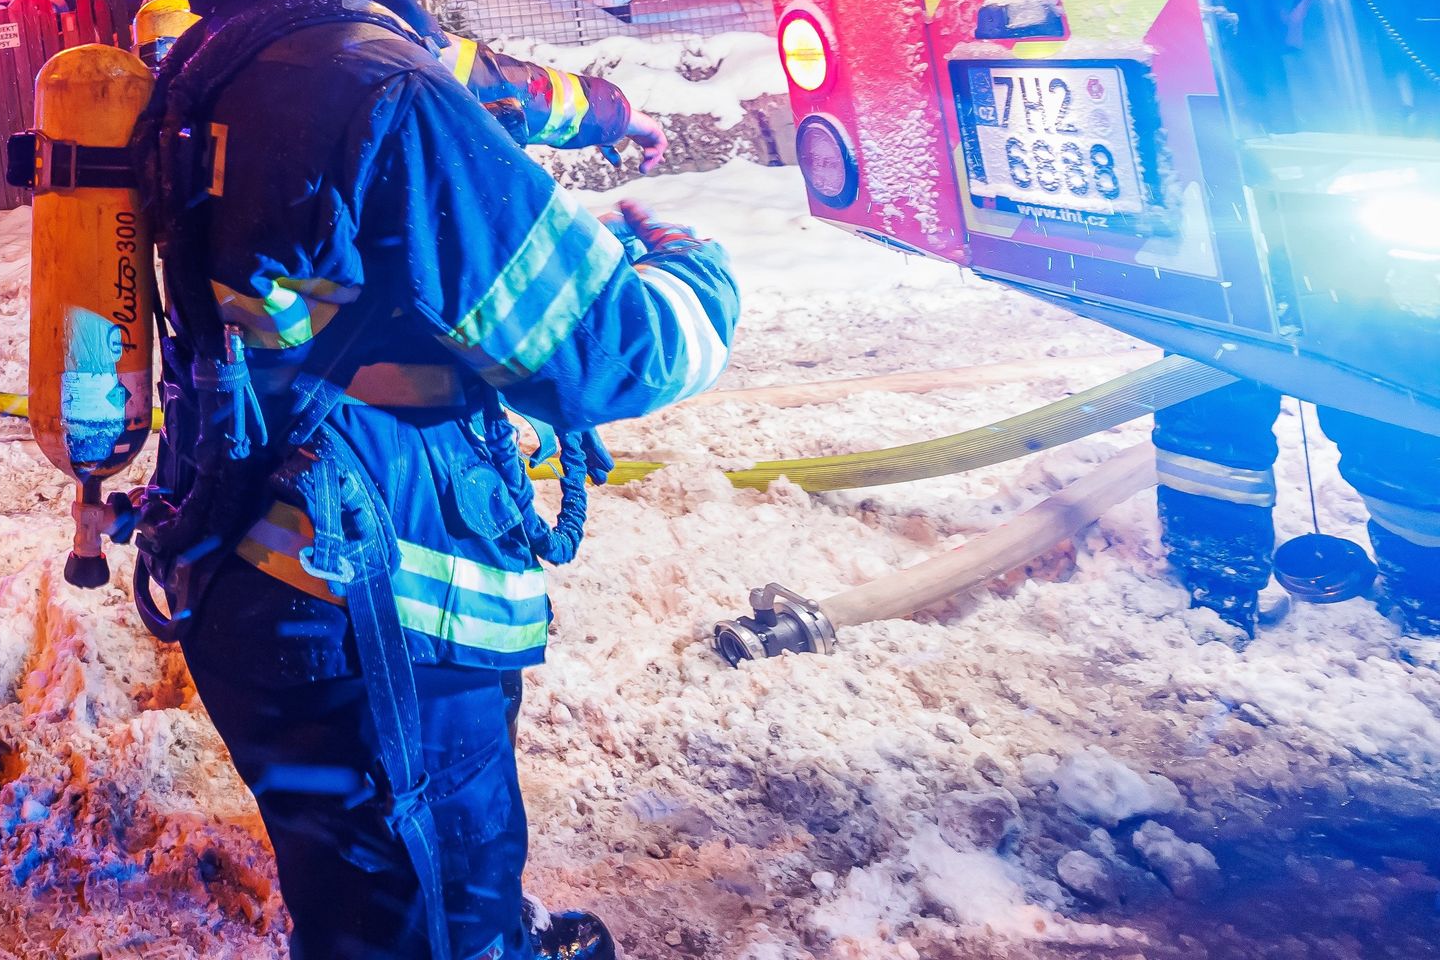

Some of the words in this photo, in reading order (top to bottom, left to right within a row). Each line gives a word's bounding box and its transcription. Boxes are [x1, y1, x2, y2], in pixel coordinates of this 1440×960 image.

[993, 76, 1079, 134] 7H2
[115, 211, 137, 254] 300
[106, 256, 137, 353] Pluto
